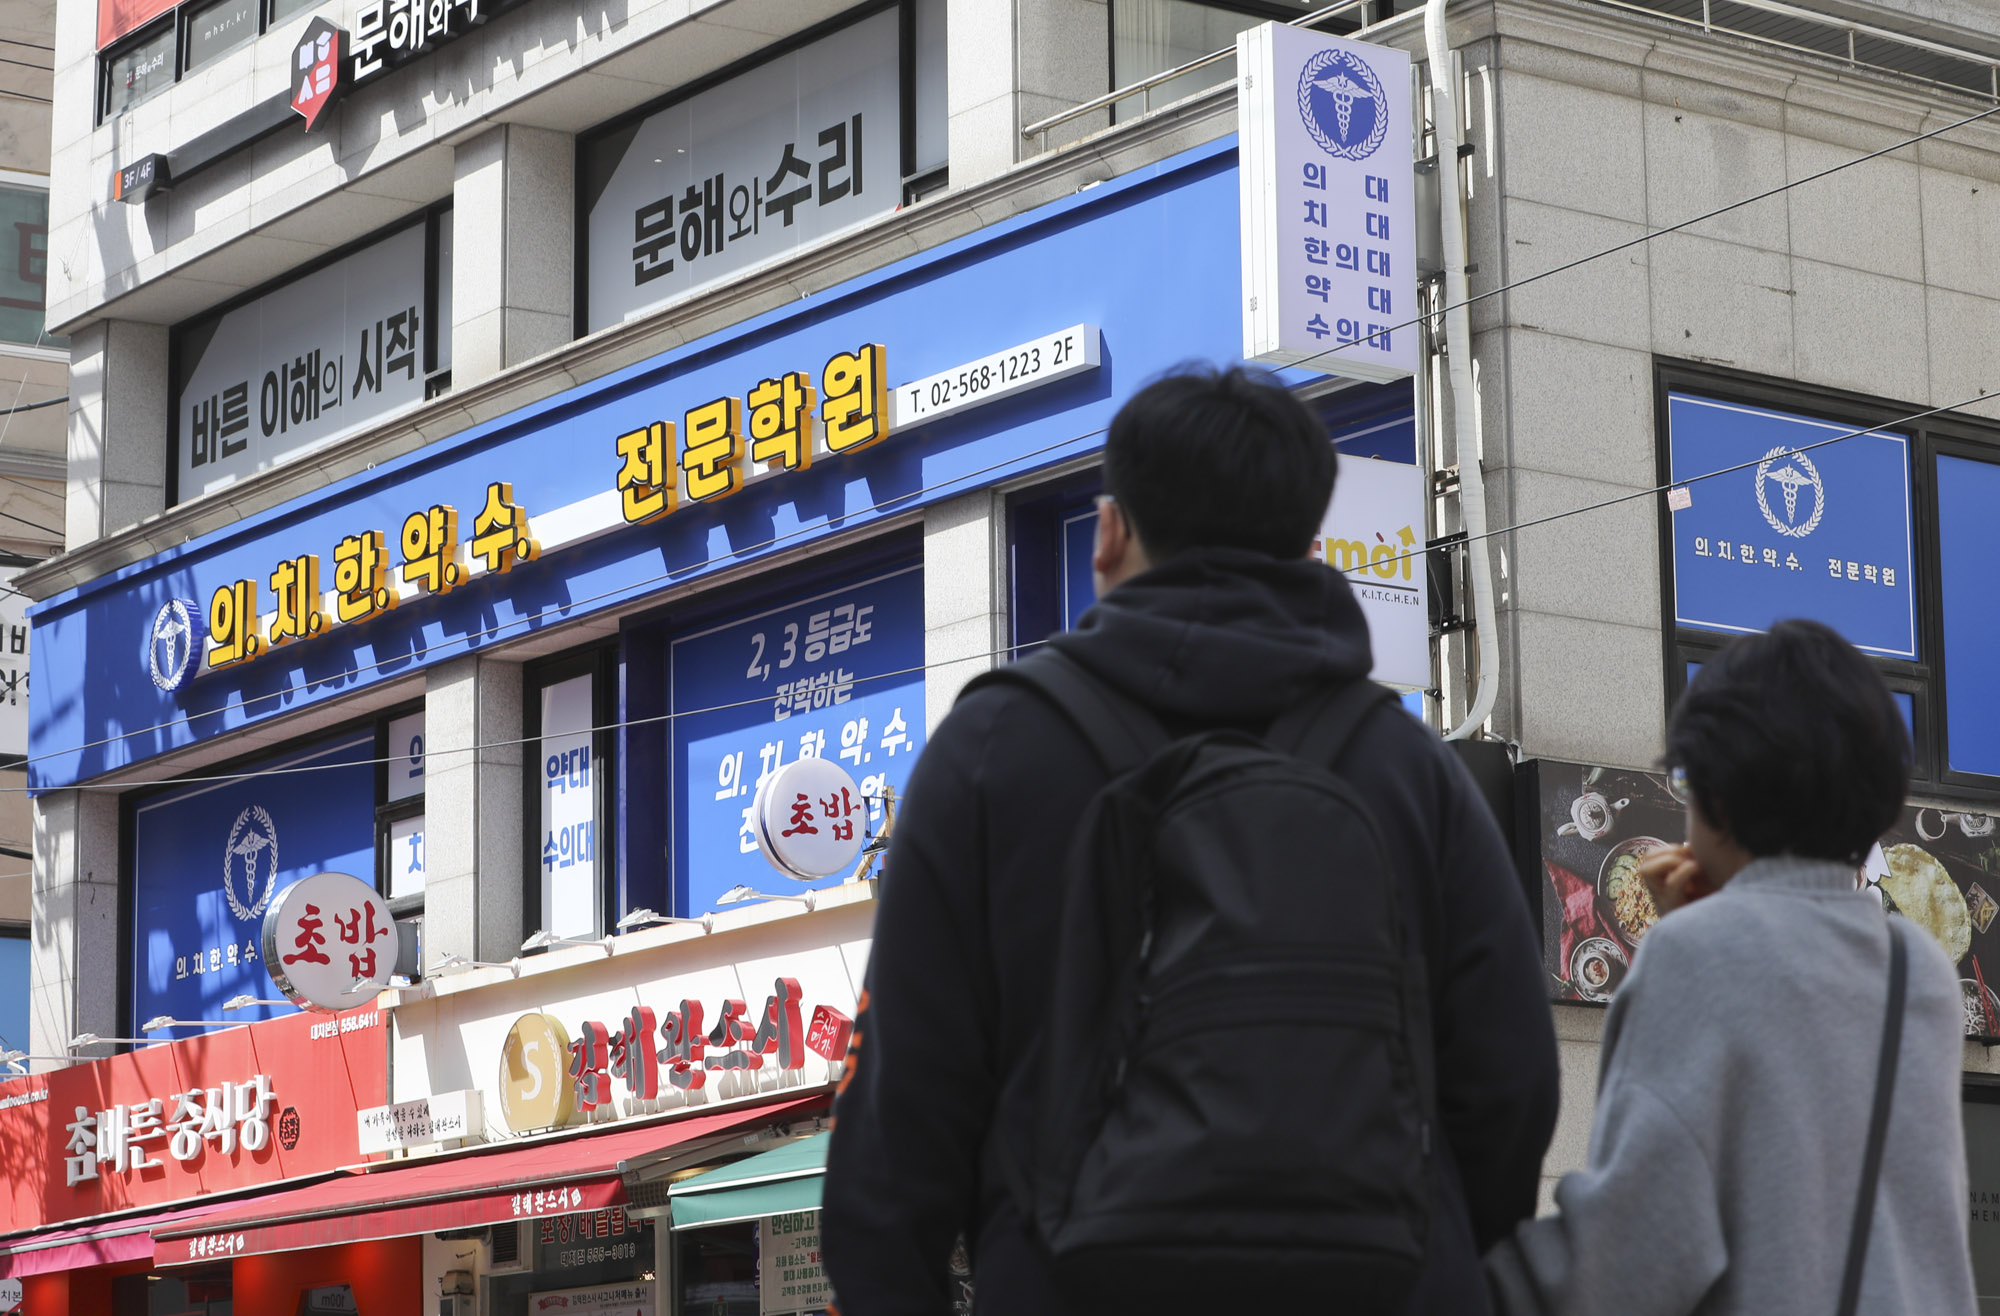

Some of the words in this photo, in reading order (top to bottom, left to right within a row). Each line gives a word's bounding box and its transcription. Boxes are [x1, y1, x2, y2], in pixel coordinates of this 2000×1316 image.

[632, 112, 863, 287] 문해와수리
[191, 380, 249, 469] 바른
[260, 348, 344, 438] 이해의
[353, 305, 419, 395] 시작
[911, 389, 926, 414] T.
[930, 347, 1042, 408] 02-568-1223
[1053, 336, 1075, 367] 2F
[616, 341, 889, 527] 전문학원
[1827, 558, 1897, 587] 전문학원
[804, 603, 874, 663] 등급도
[773, 668, 854, 722] 진학하는
[546, 745, 590, 793] 약대
[781, 786, 861, 842] 초밥
[543, 820, 593, 873] 수의대
[282, 900, 389, 979] 초밥
[340, 1010, 379, 1034] 558.6411
[64, 1074, 277, 1188] 참바른중식당
